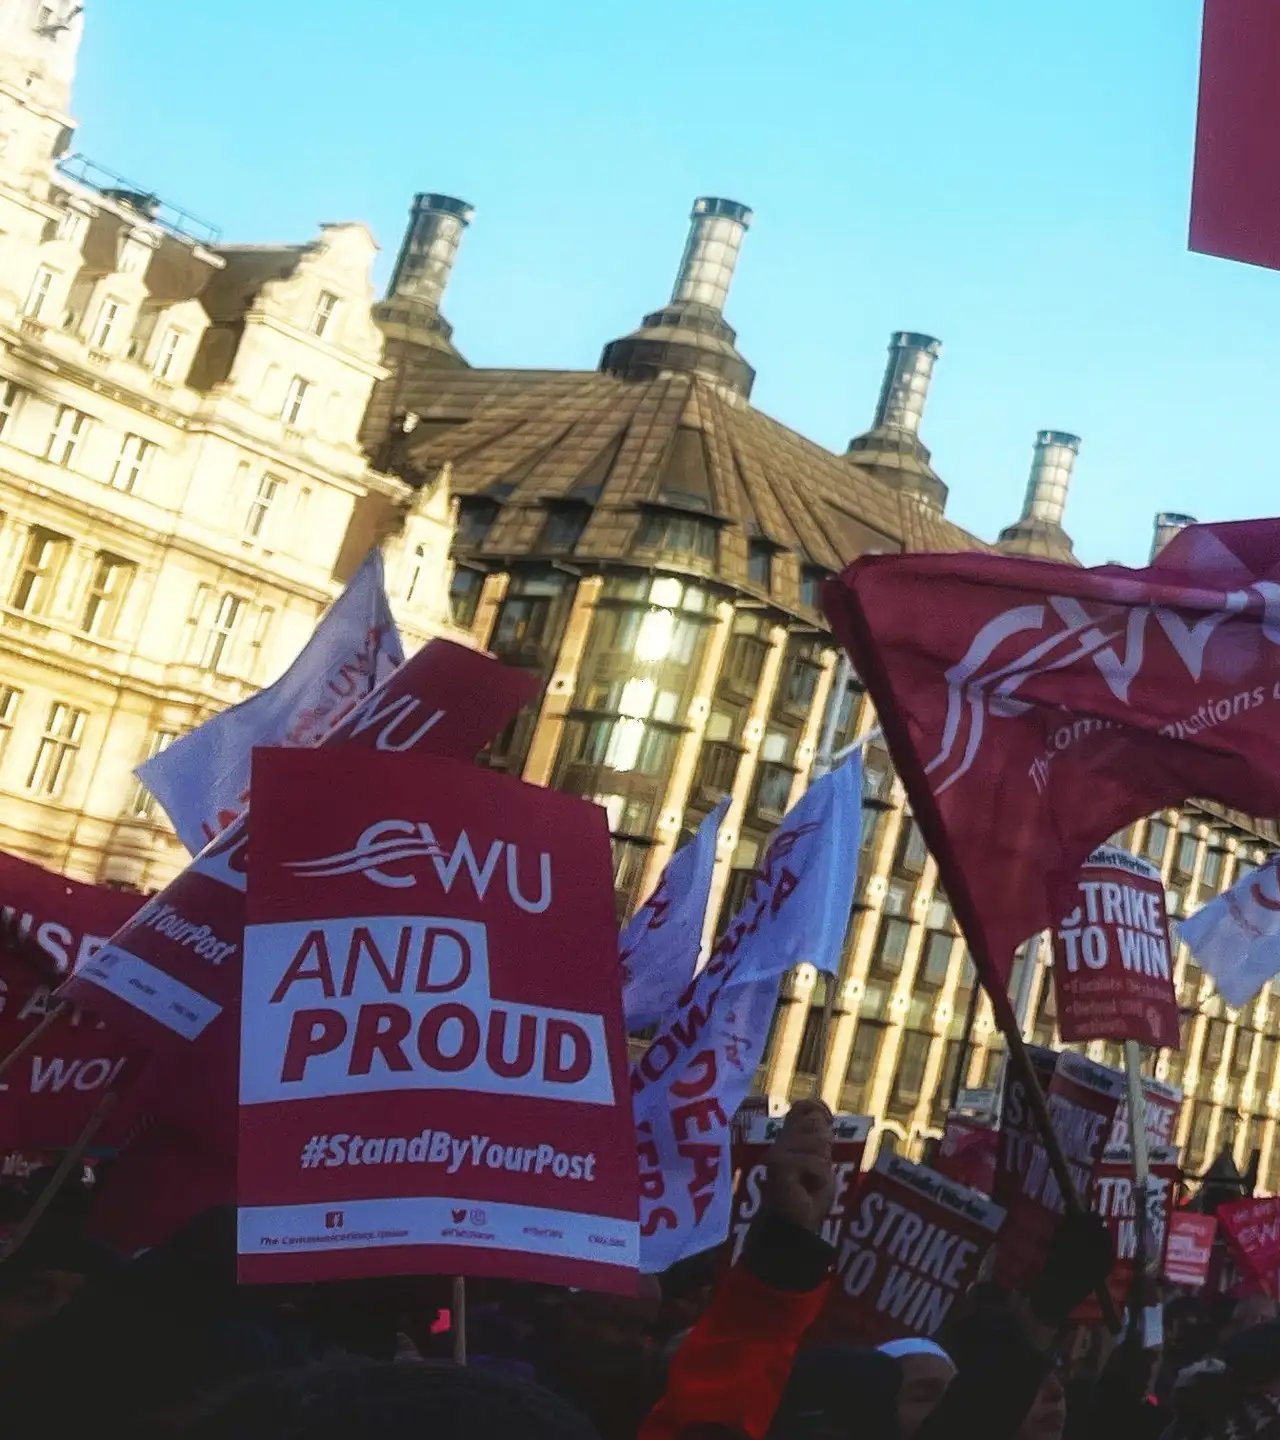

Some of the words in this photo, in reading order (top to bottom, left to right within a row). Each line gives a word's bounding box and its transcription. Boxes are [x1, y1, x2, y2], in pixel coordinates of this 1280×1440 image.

[280, 819, 552, 914] CWU
[270, 926, 472, 1003] AND
[1058, 925, 1109, 973] TO
[1116, 927, 1170, 981] WIN
[280, 1002, 593, 1084] PROUD
[300, 1128, 597, 1181] #StandByYourPost
[850, 1192, 979, 1289] STRIKE
[837, 1238, 877, 1297] TO
[876, 1264, 955, 1336] WIN
